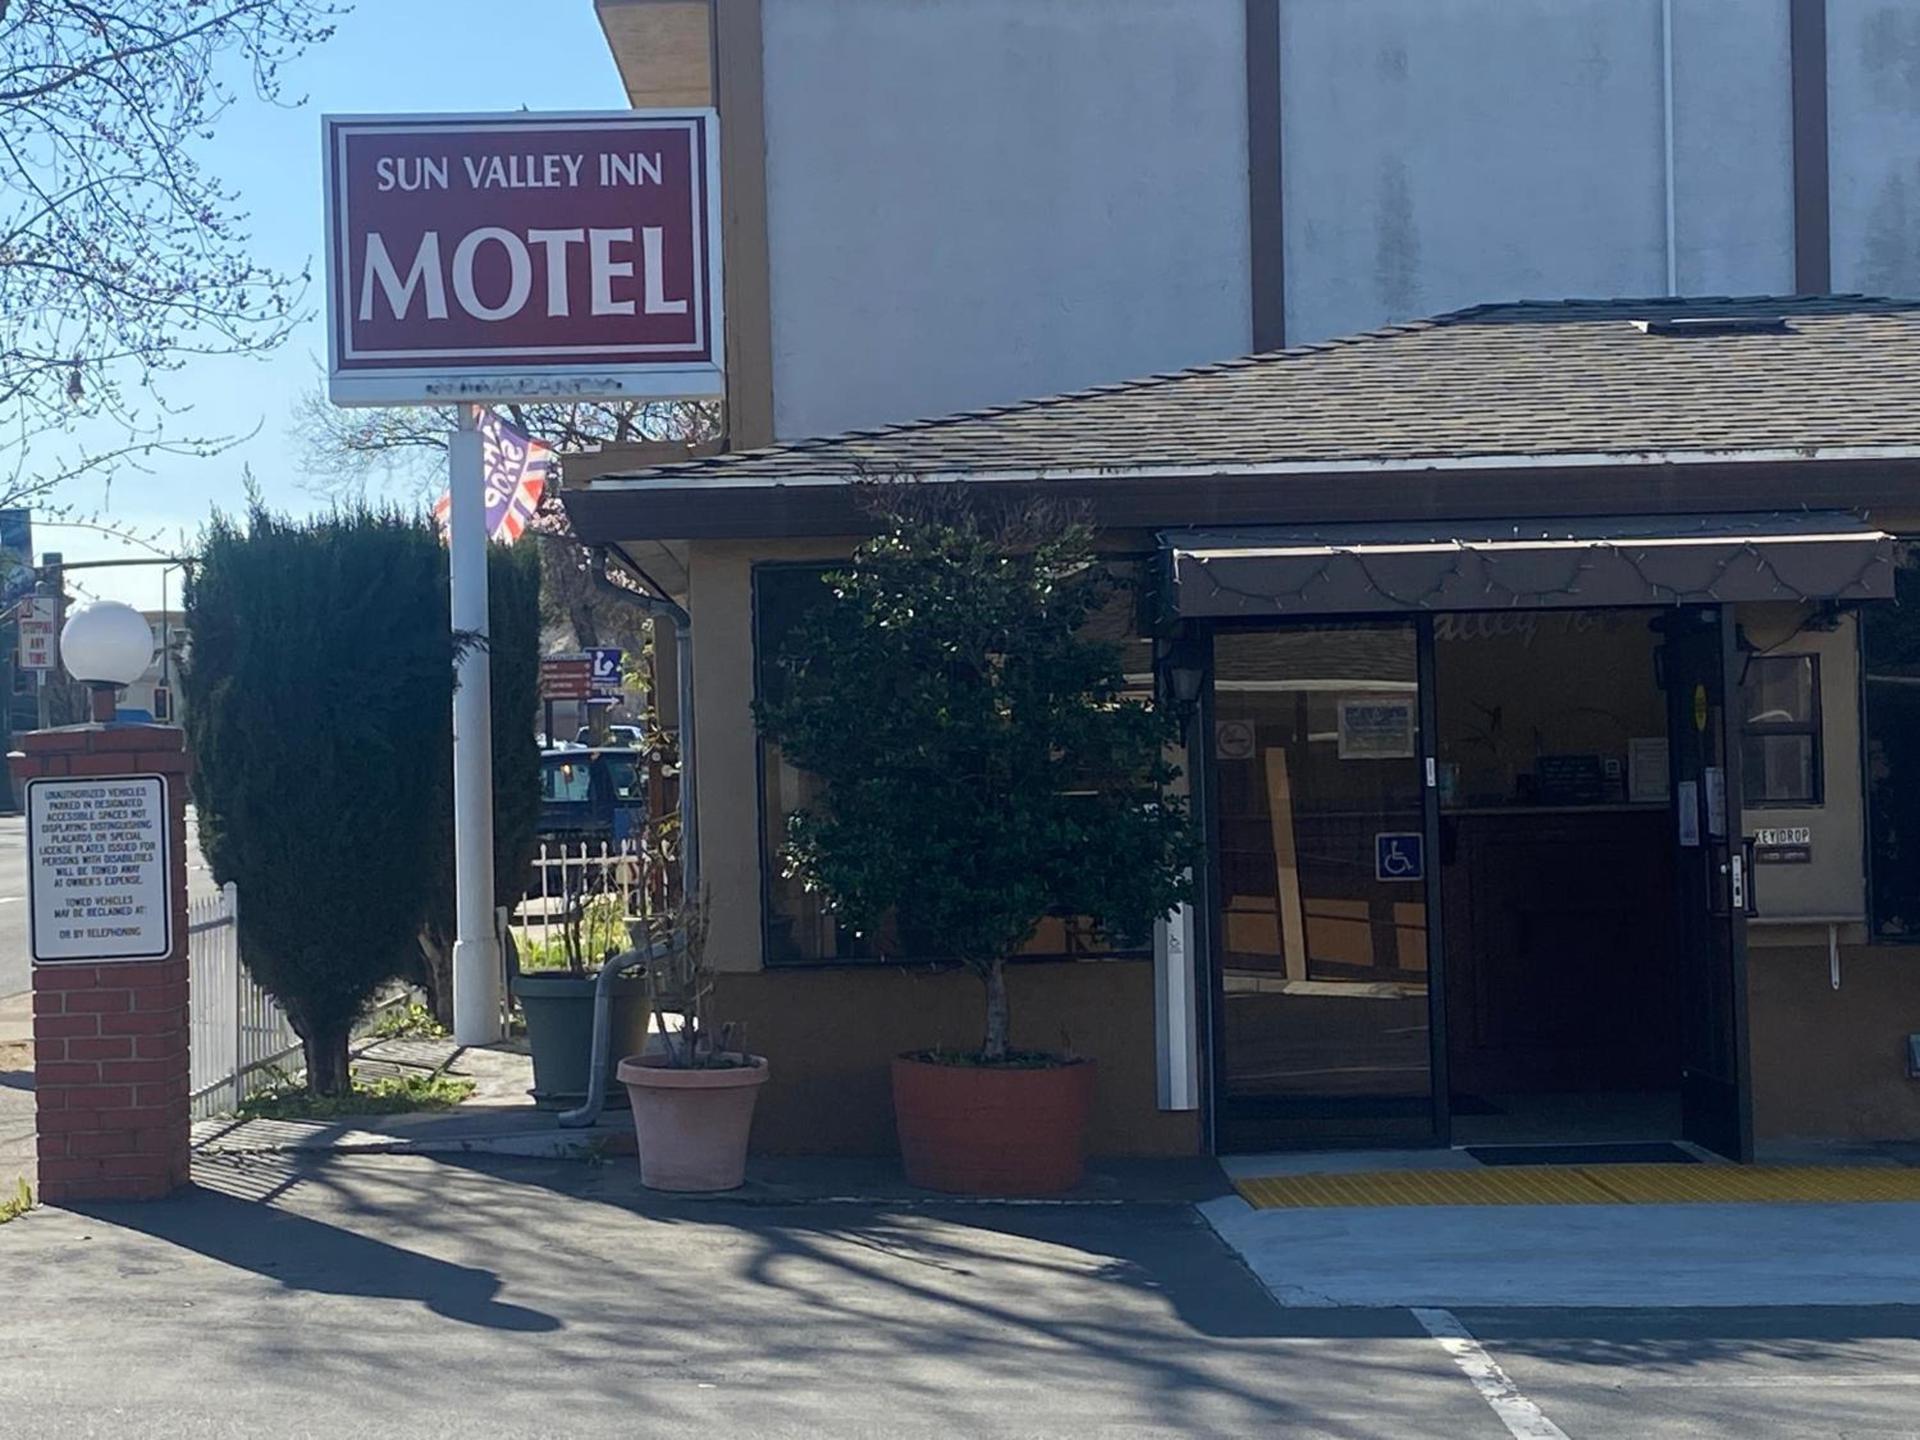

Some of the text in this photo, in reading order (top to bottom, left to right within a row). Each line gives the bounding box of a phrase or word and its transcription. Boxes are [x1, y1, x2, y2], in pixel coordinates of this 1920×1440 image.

[377, 152, 663, 191] SUN VALLEY INN
[358, 226, 688, 322] MOTEL
[108, 787, 146, 797] VEHICLES
[49, 798, 143, 811] PARKED IN DESIGNATED
[47, 809, 146, 822] ACCESSIBLE SPACES NOT
[42, 820, 152, 833] DISPLAYING DISTINGUISHING
[51, 831, 142, 844] PLACARDS OR SPECIAL
[1754, 828, 1809, 843] KEY DROP
[40, 841, 156, 855] LICENSE PLATES ISSUED FOR
[42, 853, 153, 866] PERSONS WITH DISABILITIES
[56, 864, 140, 877] WILL BE TOWED AWAY
[54, 879, 63, 888] AT
[66, 877, 102, 887] OWNER'S
[66, 895, 133, 907] TOWED VEHICLES
[54, 909, 70, 919] MAY
[73, 908, 83, 918] BE
[87, 906, 132, 917] RECLAIMED
[60, 926, 141, 939] OR BY TELEPHONING
